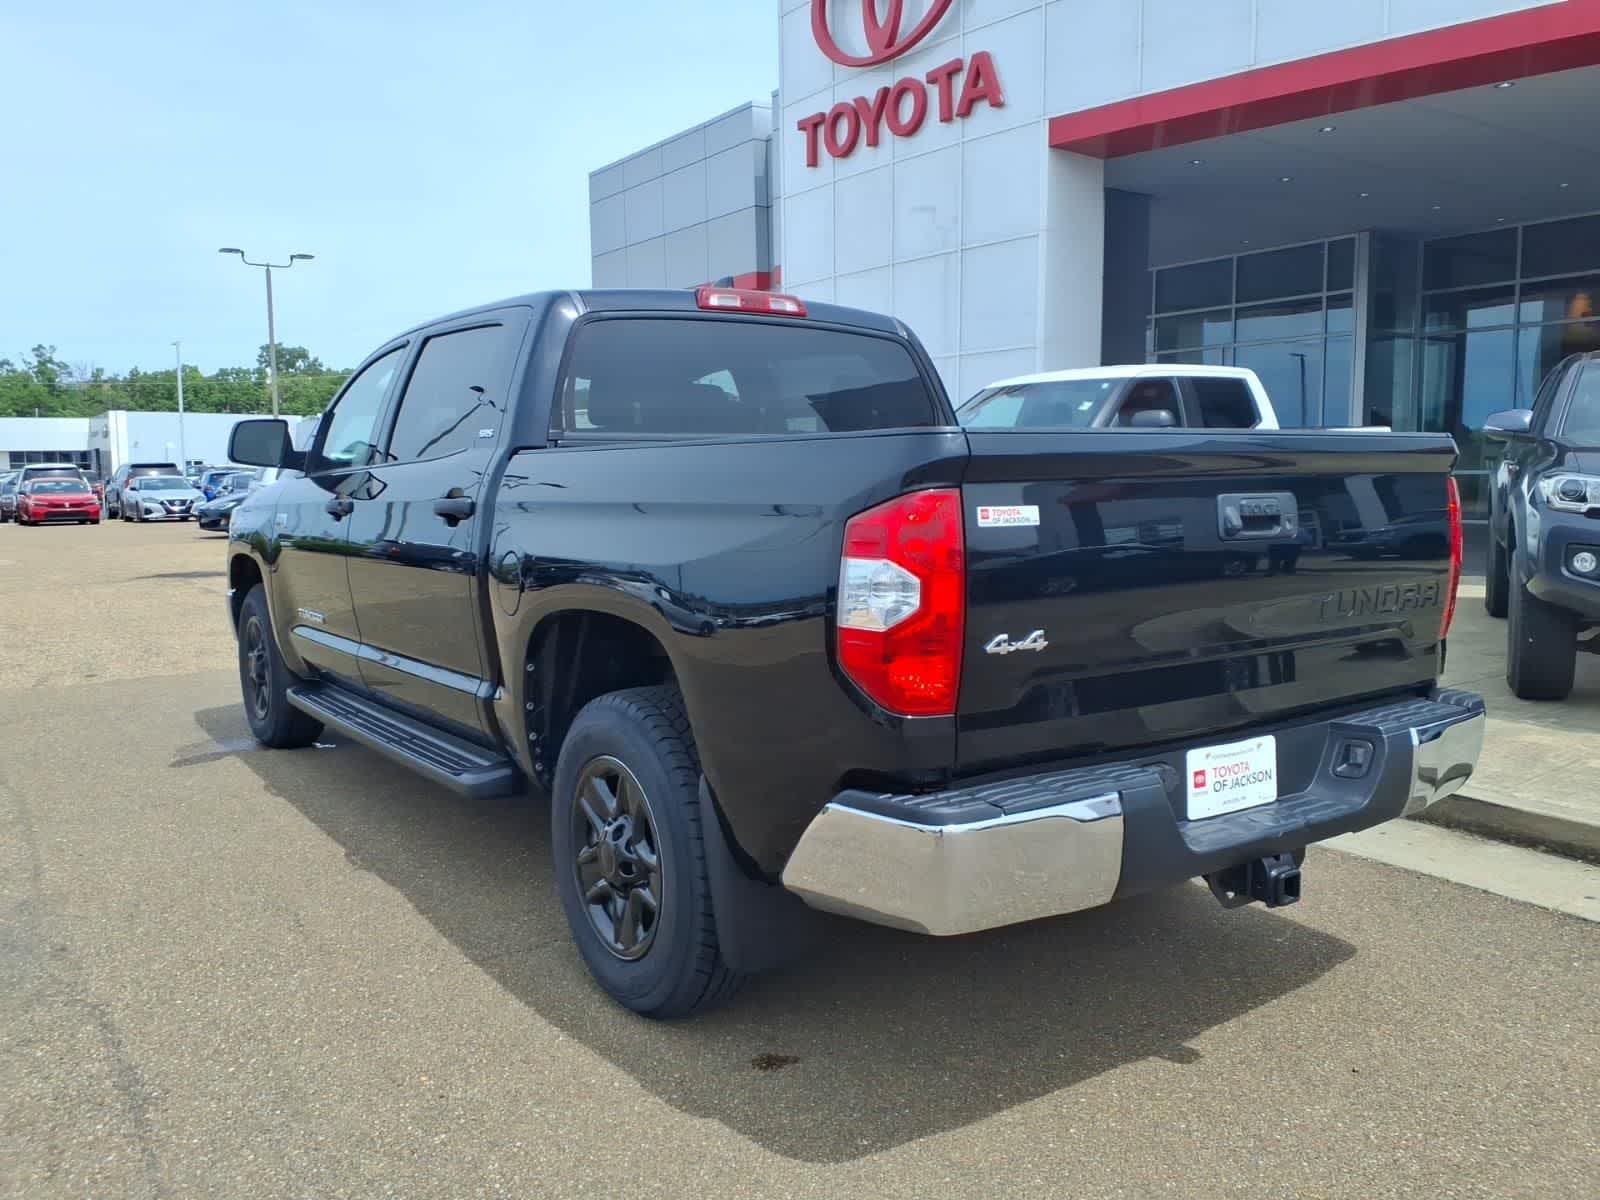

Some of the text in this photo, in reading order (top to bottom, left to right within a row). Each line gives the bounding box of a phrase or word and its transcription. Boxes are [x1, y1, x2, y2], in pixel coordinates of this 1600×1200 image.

[797, 51, 1005, 168] TOYOTA
[991, 508, 1022, 517] TOYOTA
[1319, 581, 1440, 624] TUNDRA
[1212, 761, 1251, 779] TOYOTA
[1213, 768, 1272, 793] OF JACKSON
